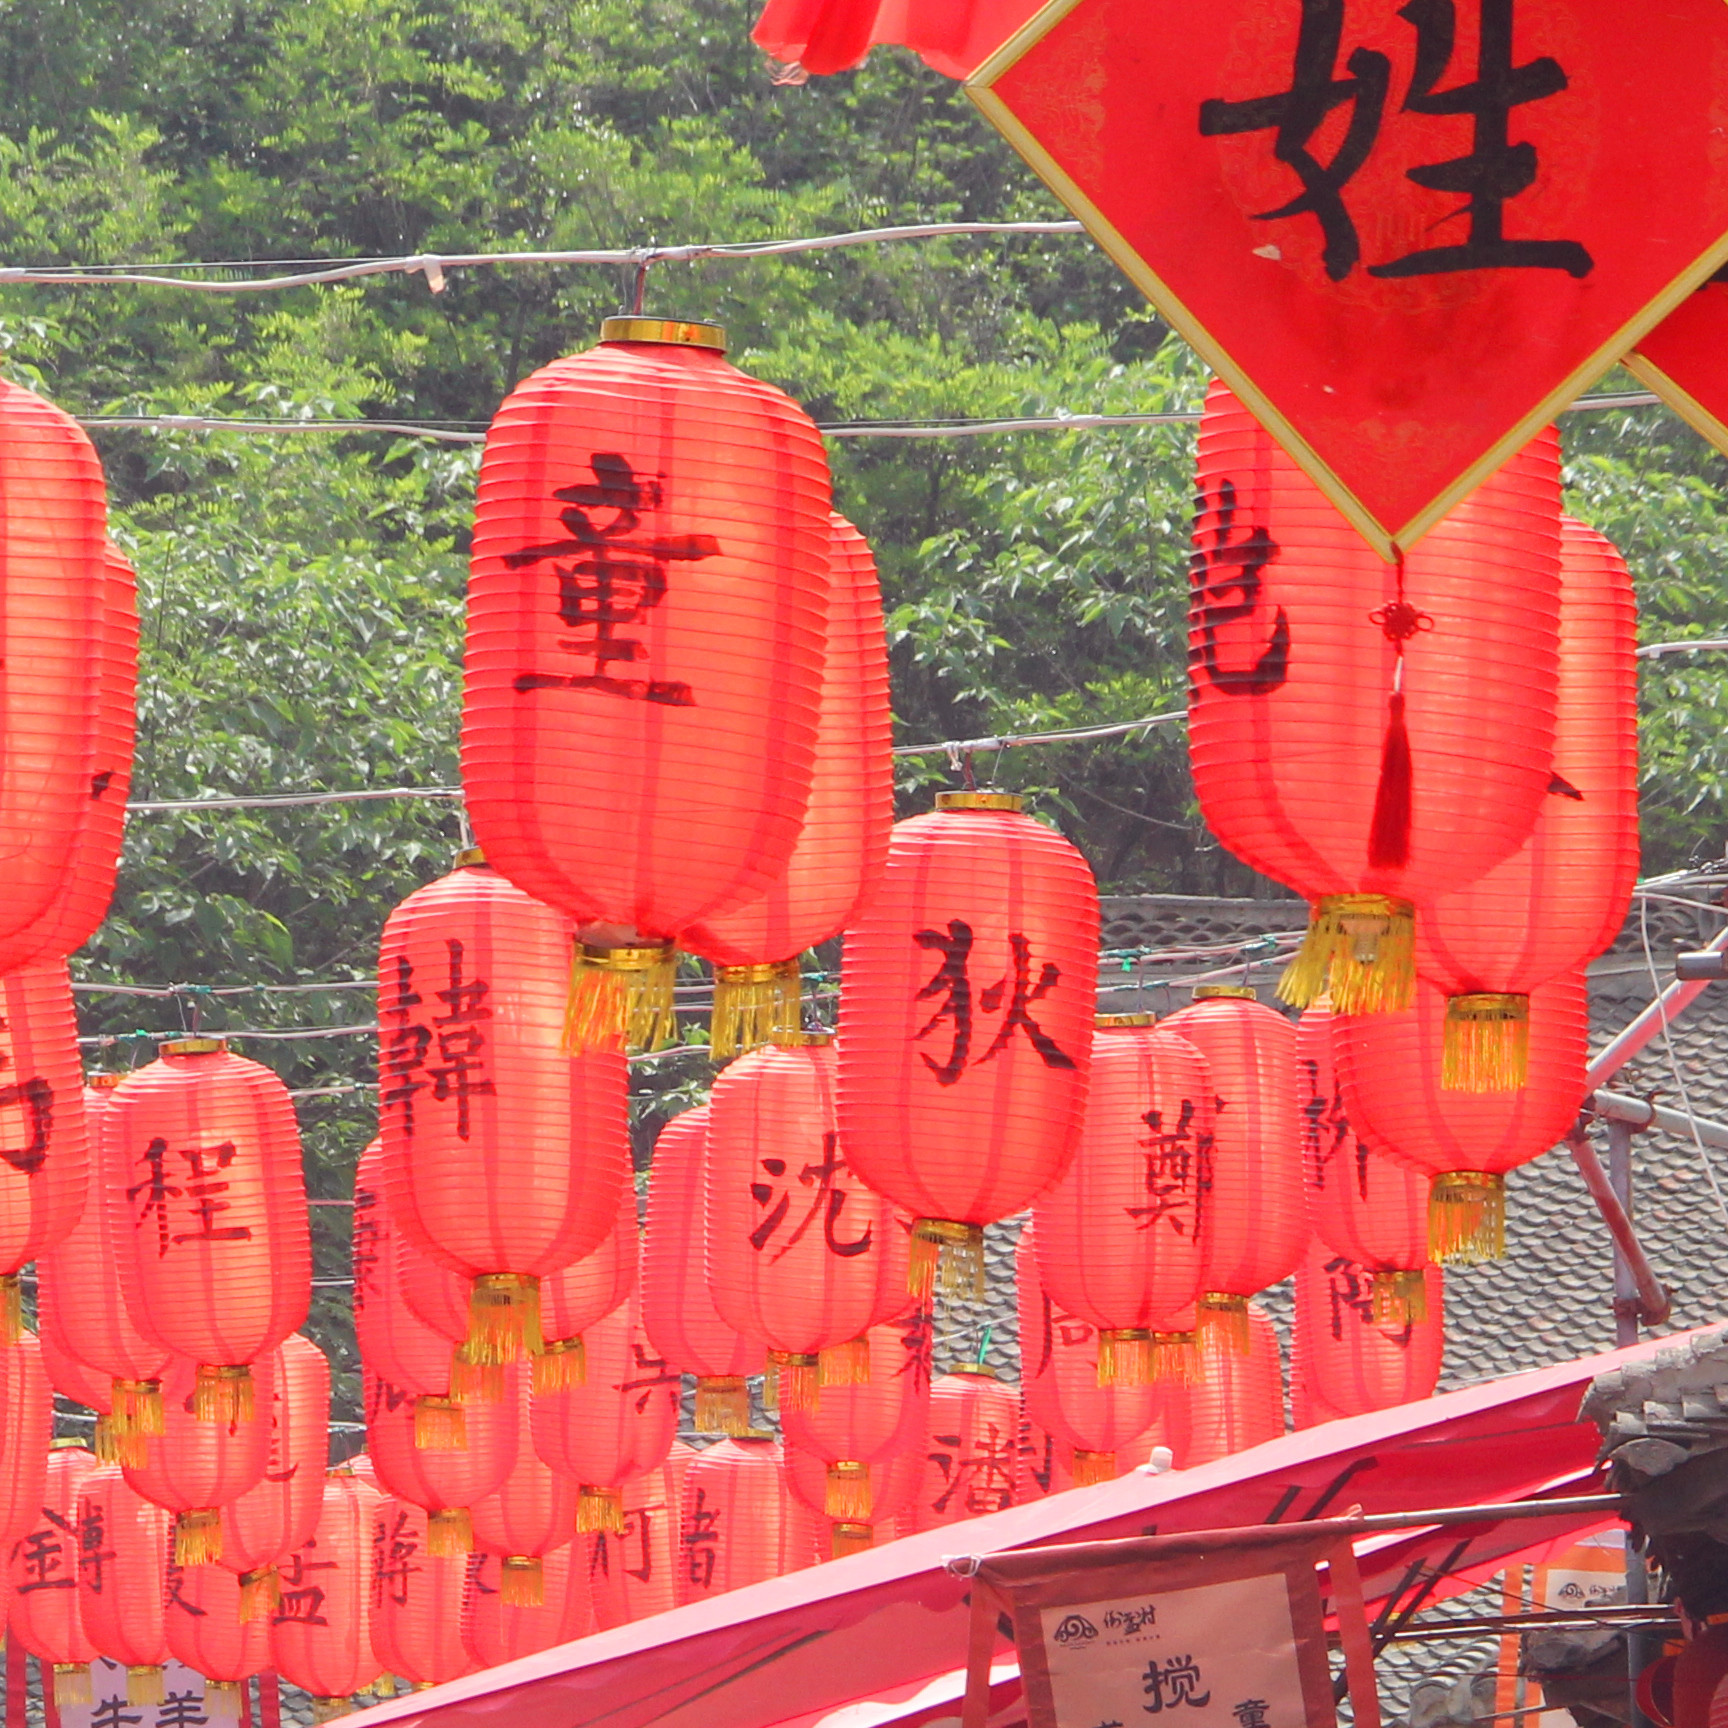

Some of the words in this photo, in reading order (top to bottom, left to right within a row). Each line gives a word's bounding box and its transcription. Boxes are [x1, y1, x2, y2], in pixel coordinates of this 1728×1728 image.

[1197, 0, 1596, 284] 姓
[501, 452, 721, 706] 童
[382, 938, 496, 1142] 韓
[911, 918, 1079, 1087] 狄
[125, 1136, 253, 1260] 程
[749, 1133, 874, 1266] 沈
[1123, 1093, 1229, 1246] 鄭
[271, 1538, 340, 1627] 孟
